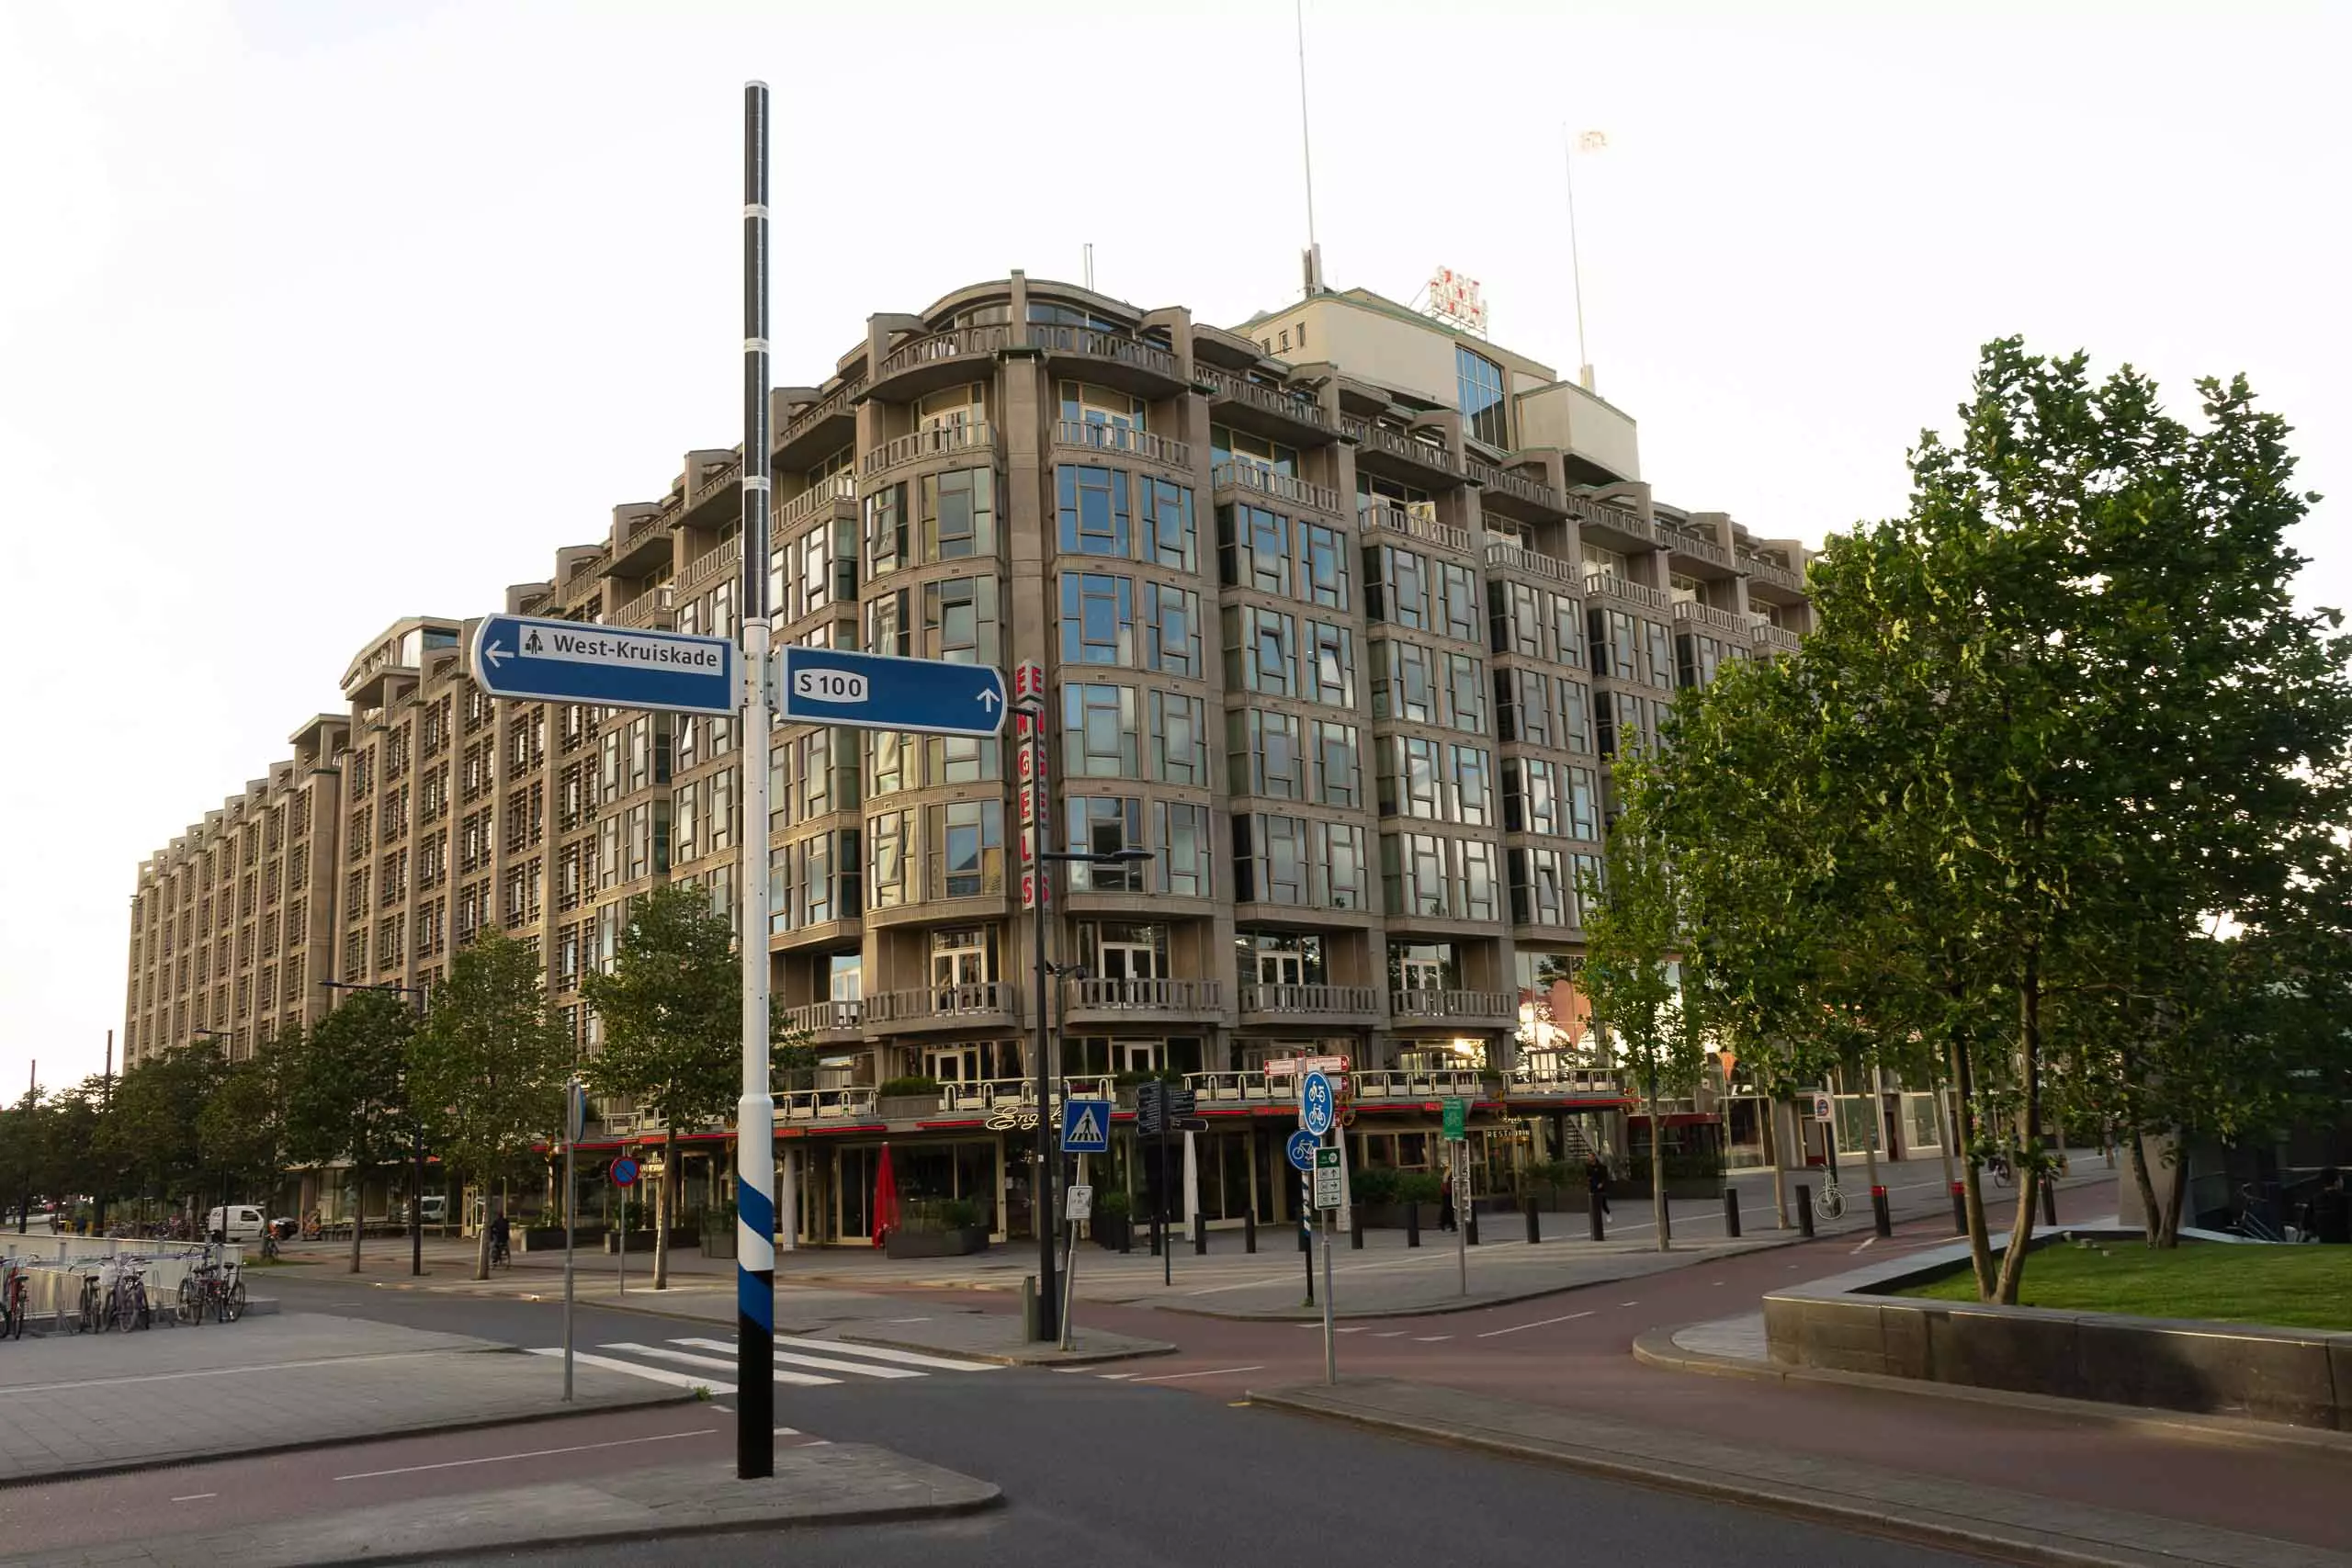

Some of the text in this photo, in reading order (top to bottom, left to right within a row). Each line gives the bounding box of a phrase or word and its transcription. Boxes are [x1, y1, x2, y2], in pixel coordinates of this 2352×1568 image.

[553, 634, 718, 668] West-Kruiskade
[800, 673, 862, 697] S 100
[1016, 665, 1033, 904] ENGELS
[986, 1105, 1062, 1131] Engl
